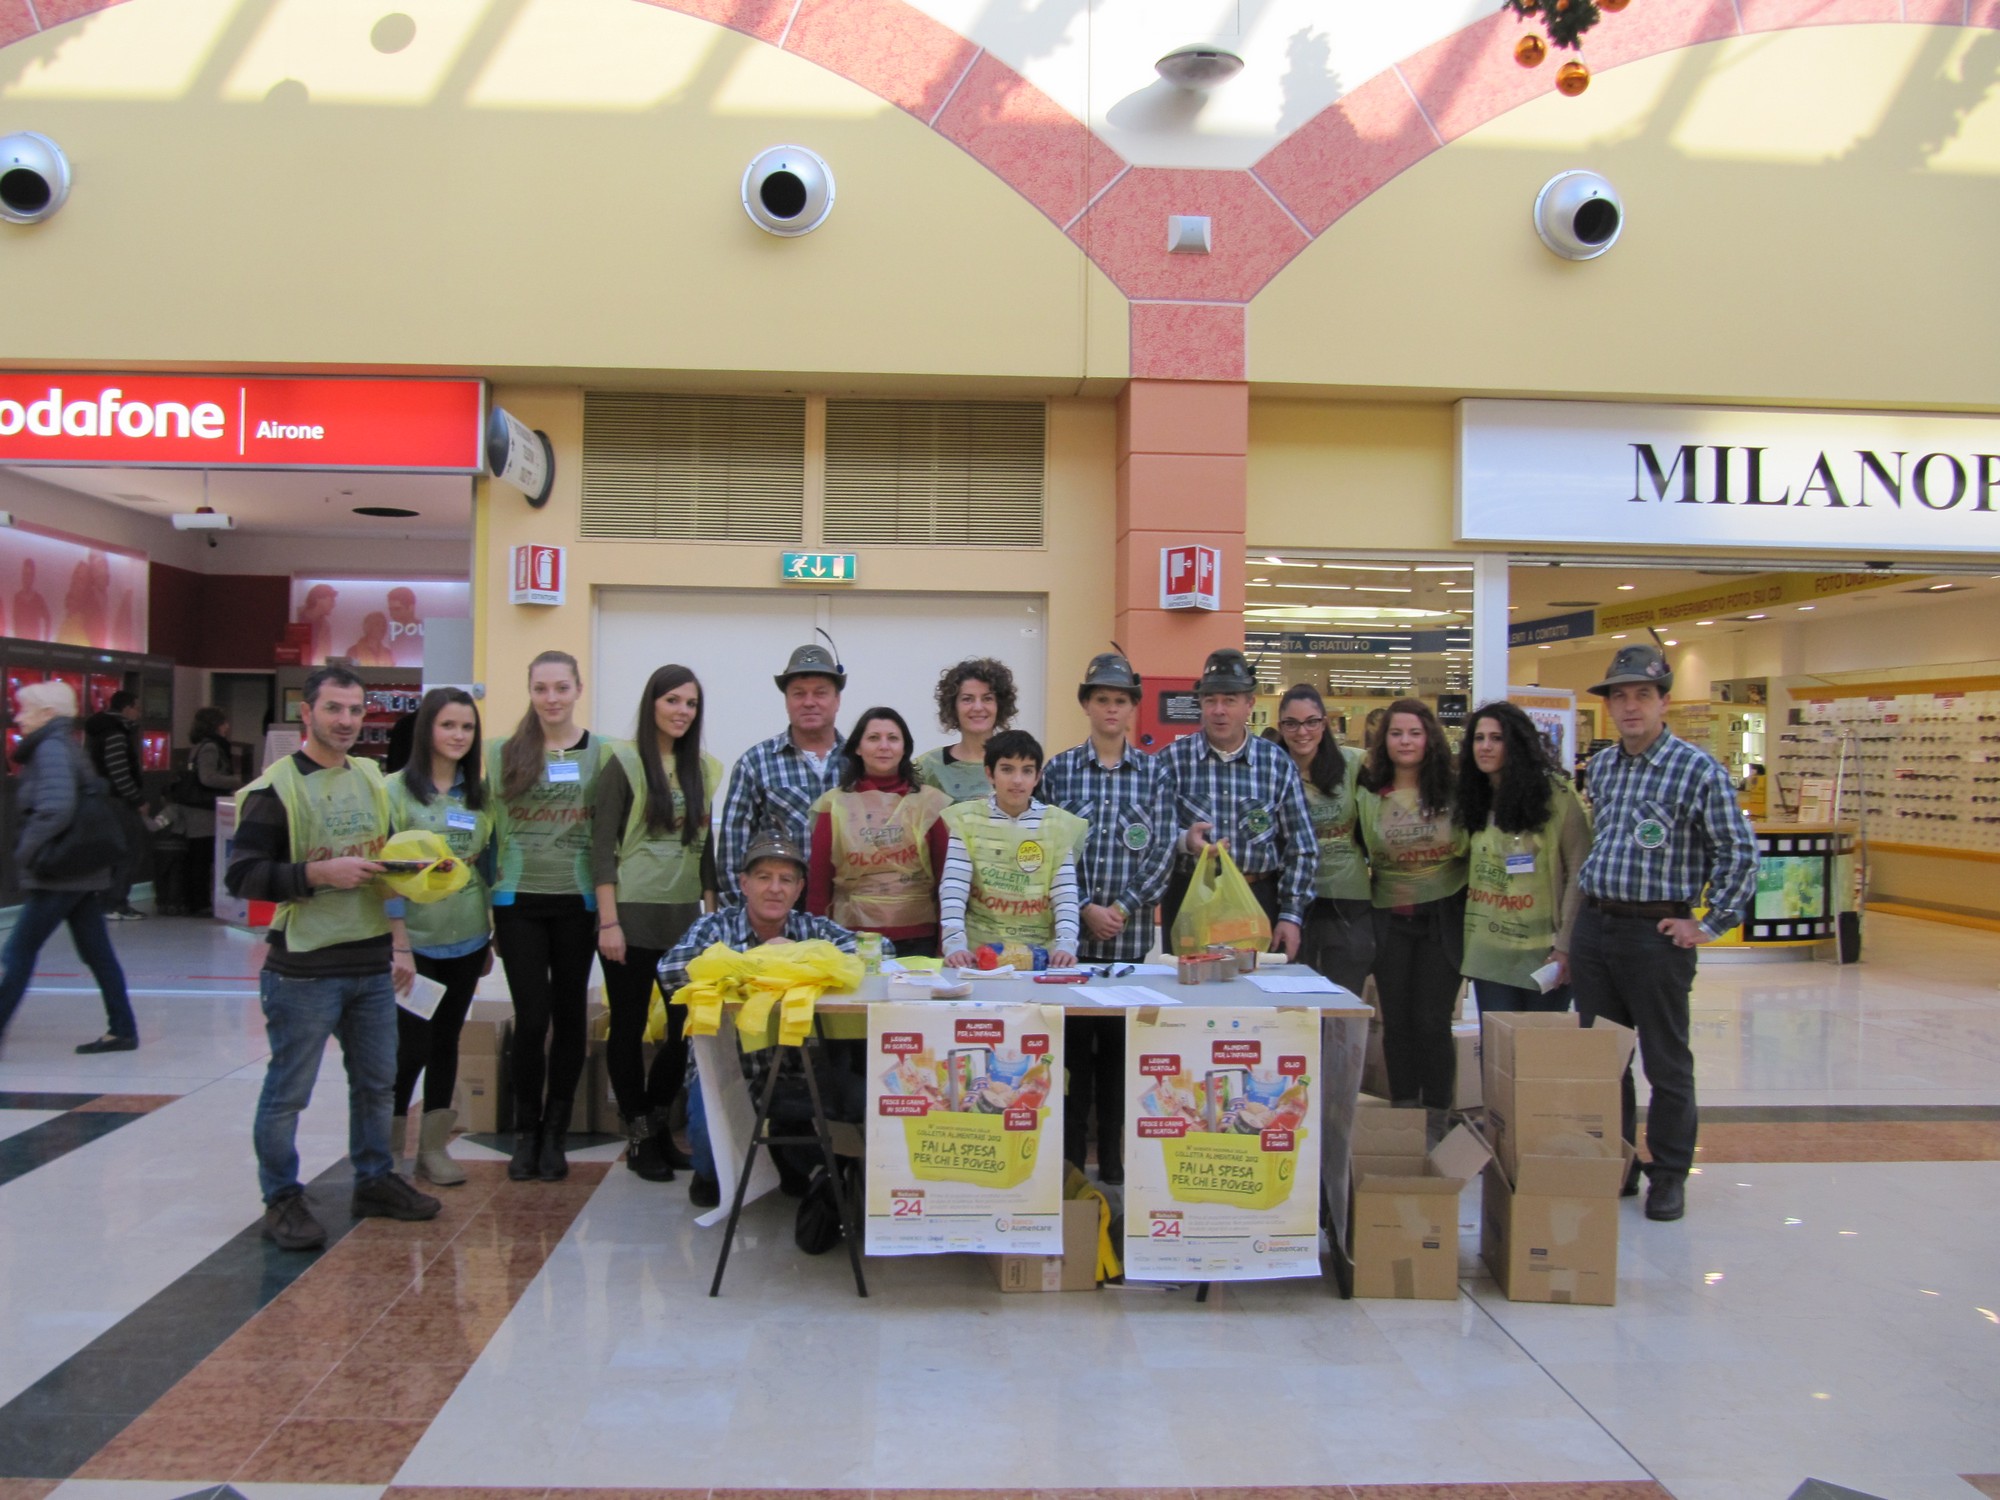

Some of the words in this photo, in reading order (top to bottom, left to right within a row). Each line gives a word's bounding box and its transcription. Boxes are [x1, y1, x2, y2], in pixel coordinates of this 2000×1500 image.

[256, 420, 325, 440] Airone
[1815, 576, 1842, 593] FOTO
[1602, 616, 1619, 629] FOTO
[1621, 610, 1656, 624] TESSERA
[1658, 597, 1726, 621] TRASFERIMENTO
[1727, 592, 1750, 607] FOTO
[1535, 624, 1570, 640] CONTATTO
[1269, 640, 1303, 651] VISTA
[1309, 640, 1371, 651] GRATUITO
[1385, 825, 1438, 839] COLLETTA
[1020, 846, 1038, 854] CAPO
[1019, 854, 1041, 862] EQUIPE
[980, 866, 1031, 886] COLLETTA
[1027, 1040, 1043, 1048] OLIO
[1284, 1061, 1301, 1069] OLIO
[894, 1106, 921, 1114] SCATOLA
[917, 1129, 946, 1138] COLLETTA
[947, 1131, 985, 1141] ALIMENTARE
[921, 1140, 939, 1153] FAI
[942, 1142, 957, 1154] LA
[960, 1143, 996, 1158] SPESA
[1175, 1150, 1204, 1159] COLLETTA
[1205, 1152, 1243, 1162] ALIMENTARE
[913, 1152, 932, 1165] PER
[934, 1154, 950, 1167] CHI
[952, 1156, 960, 1167] E
[962, 1157, 1006, 1172] POVERO
[1179, 1161, 1196, 1174] FAI
[1199, 1163, 1214, 1175] LA
[1218, 1165, 1254, 1180] SPESA
[1171, 1174, 1191, 1187] PER
[1192, 1176, 1208, 1188] CHI
[1211, 1177, 1218, 1188] E
[1220, 1178, 1264, 1193] POVERO
[893, 1199, 923, 1217] 24
[1010, 1224, 1052, 1232] Alimentare
[1151, 1219, 1181, 1238] 24
[1267, 1245, 1309, 1253] Alimentare
